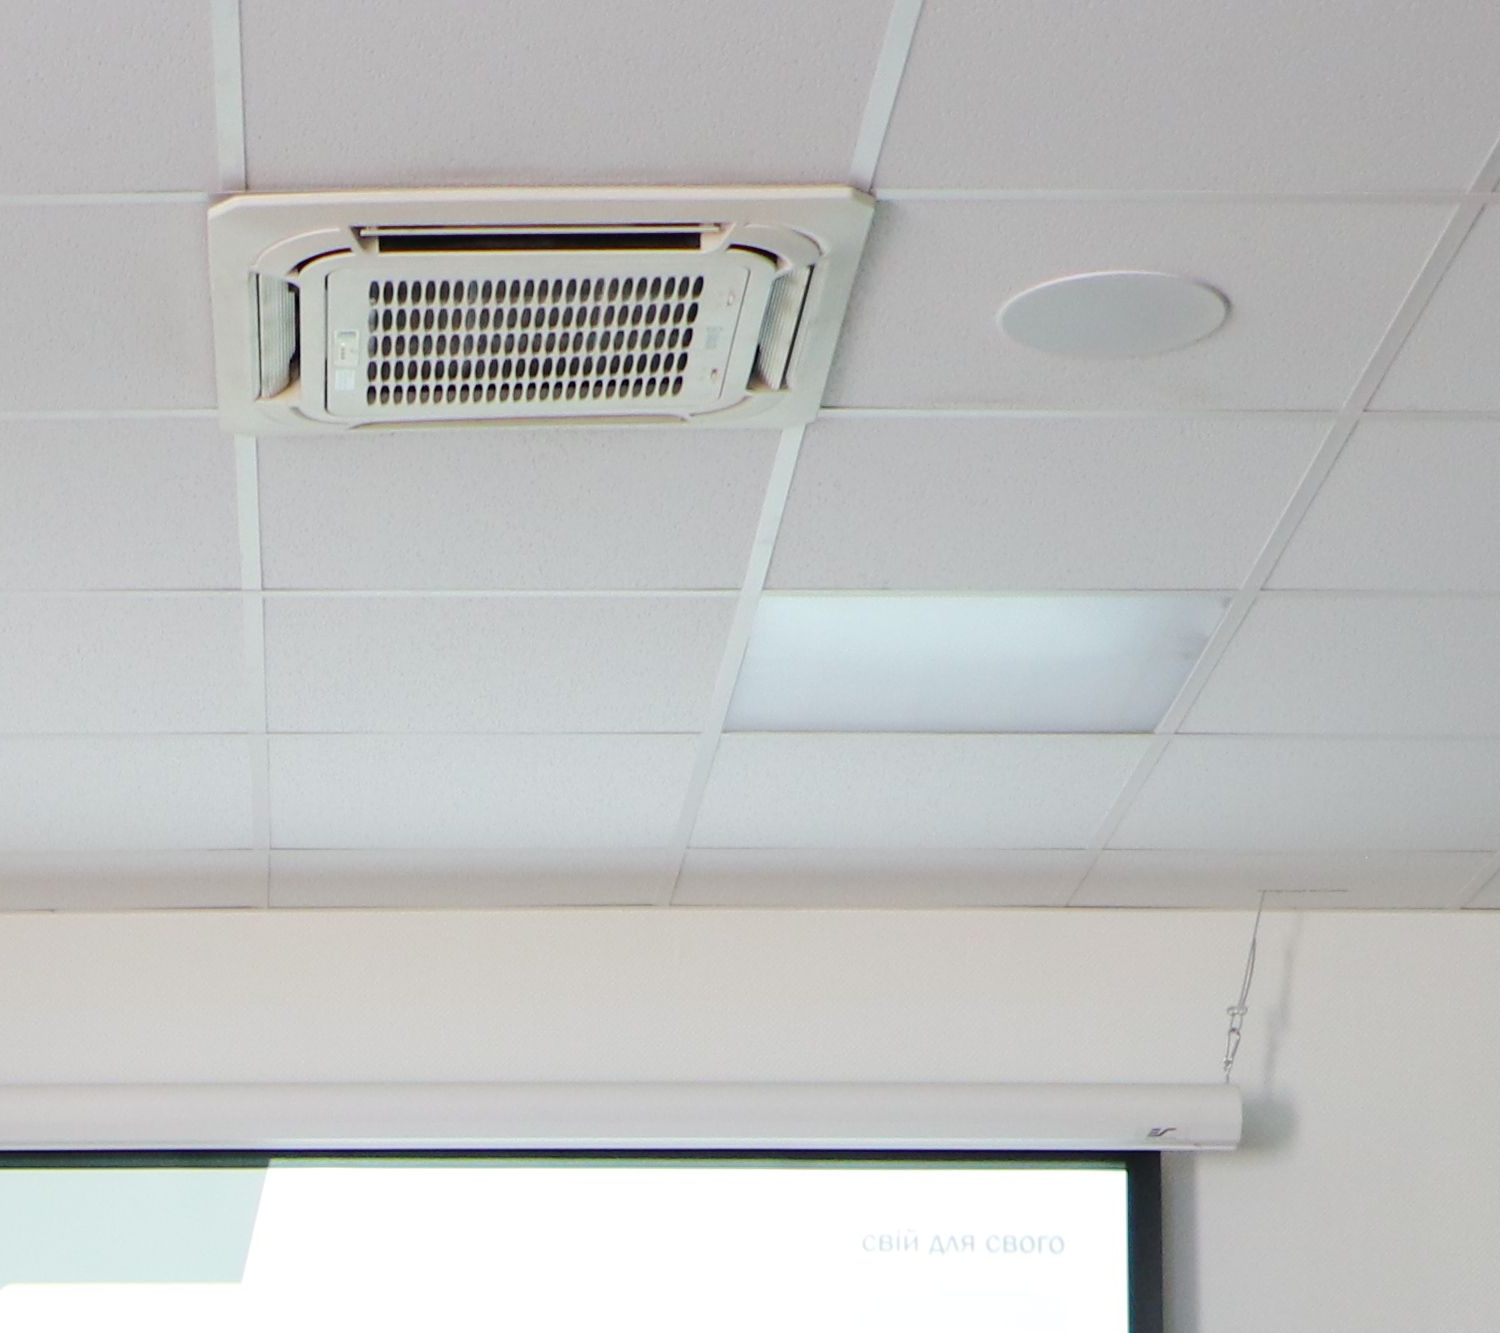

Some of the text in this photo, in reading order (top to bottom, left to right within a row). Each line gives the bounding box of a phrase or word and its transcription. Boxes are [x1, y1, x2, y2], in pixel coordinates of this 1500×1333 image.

[861, 1228, 1066, 1255] свій для свого
